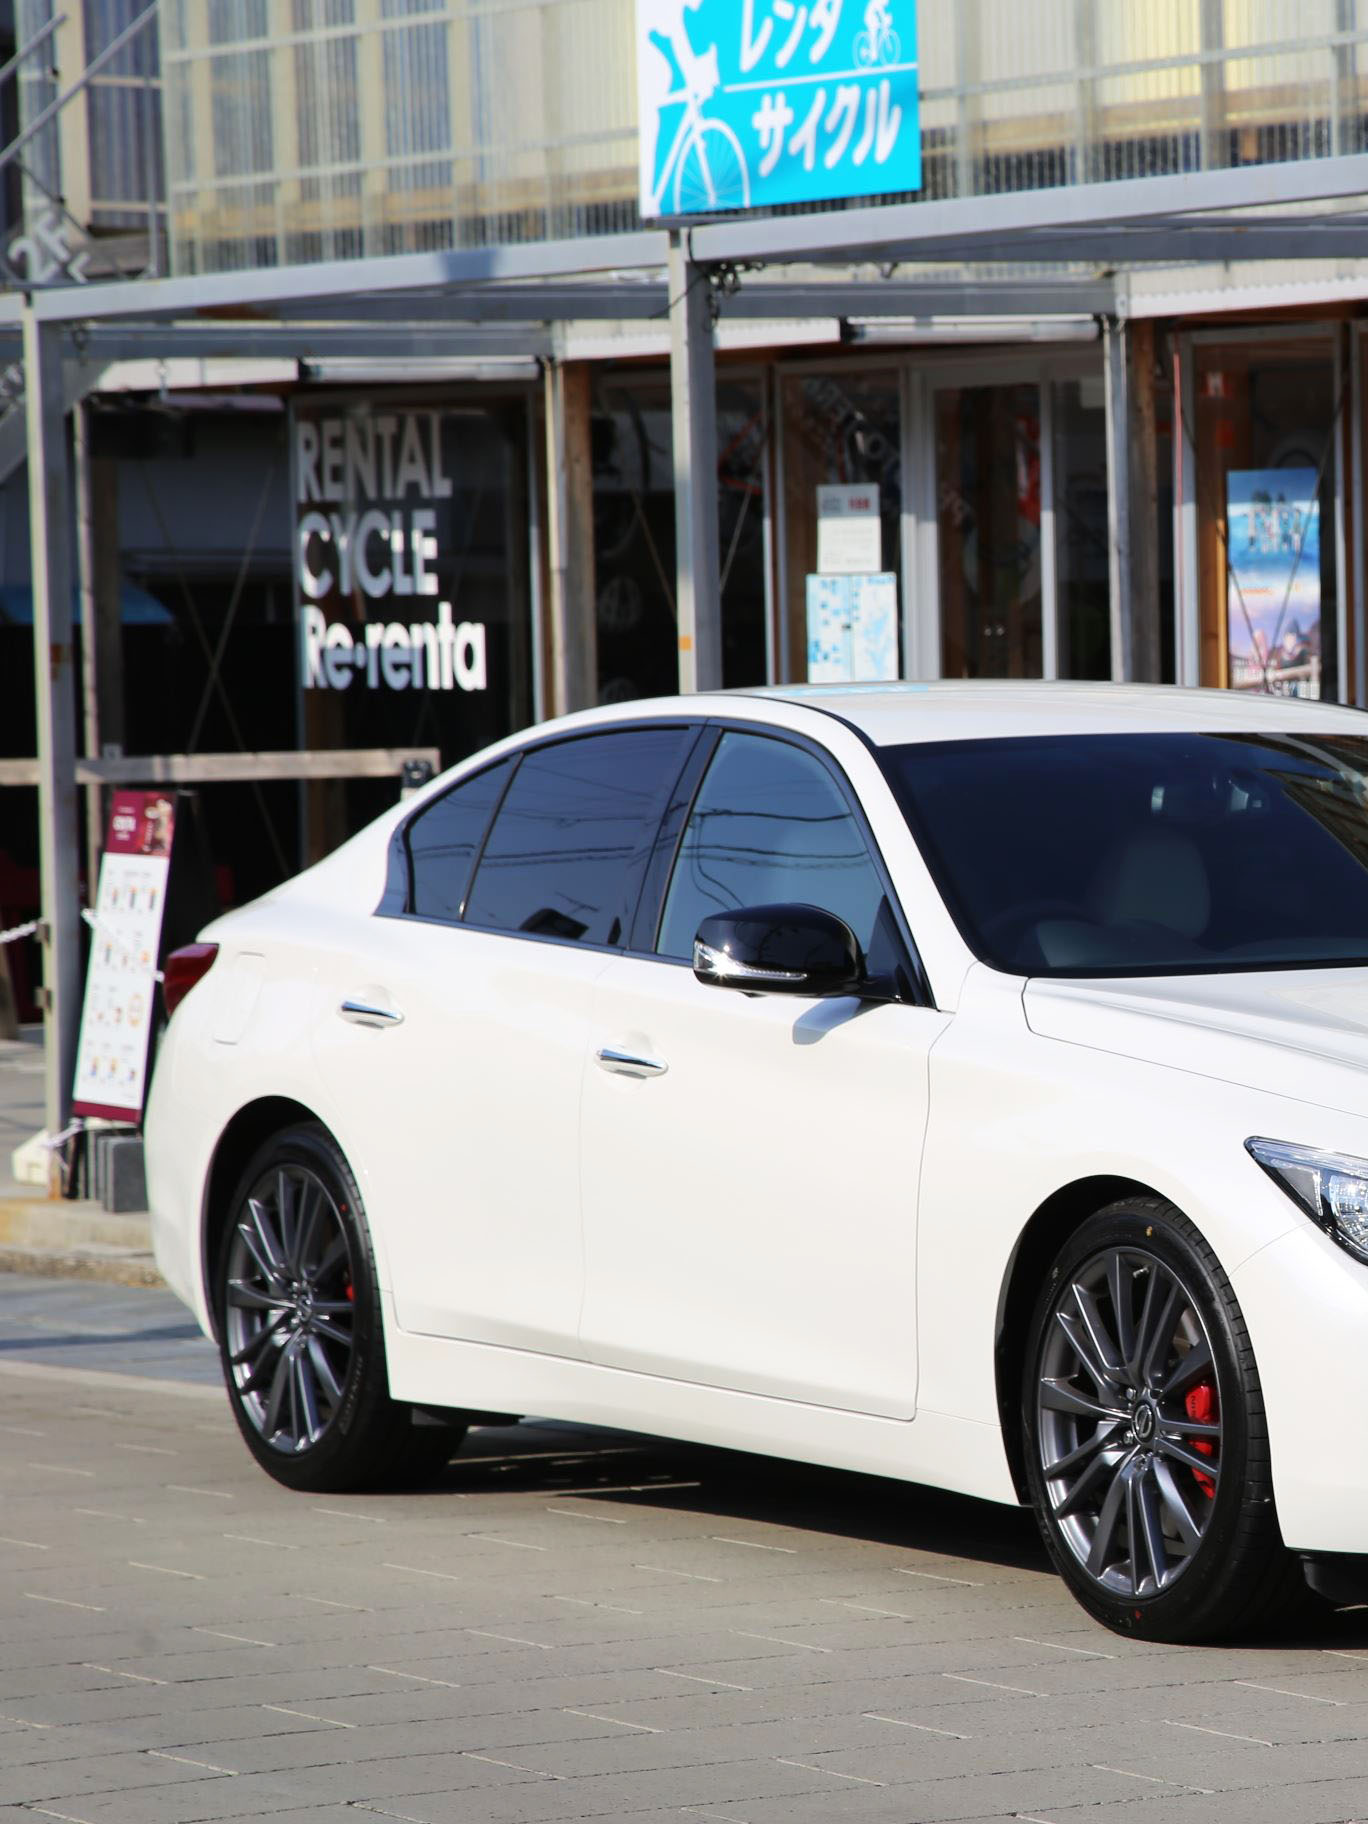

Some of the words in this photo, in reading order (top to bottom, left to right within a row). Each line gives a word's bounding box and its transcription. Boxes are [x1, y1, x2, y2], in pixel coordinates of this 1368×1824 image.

[740, 0, 844, 73] レンタ
[752, 79, 902, 178] サイクル
[298, 413, 453, 503] RENTAL
[298, 508, 439, 598] CYCLE
